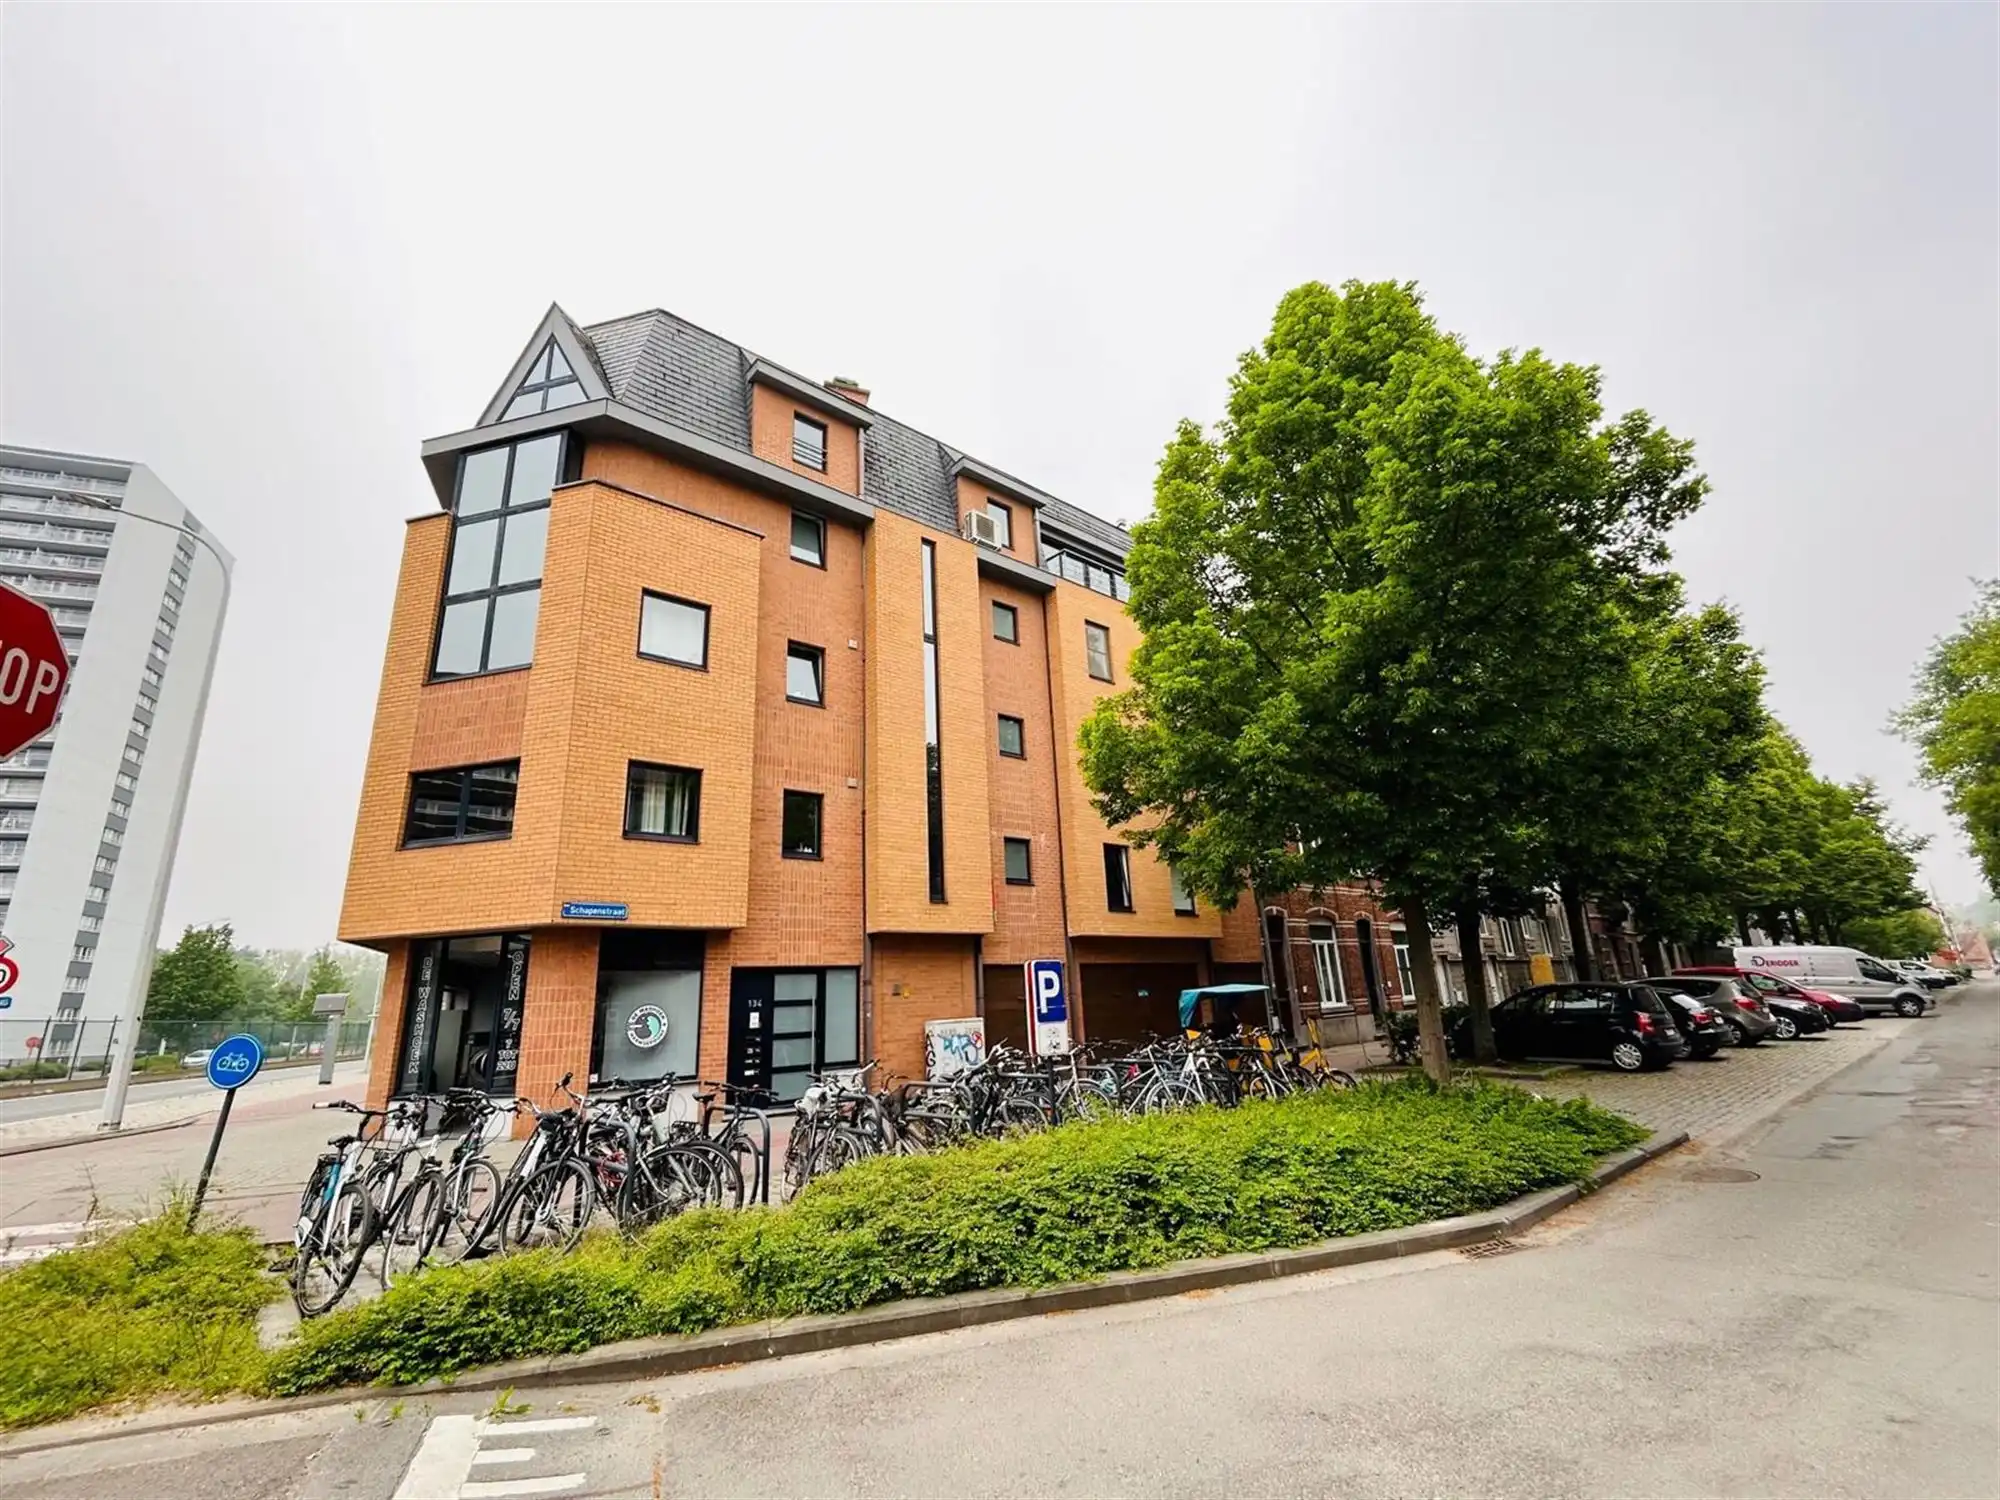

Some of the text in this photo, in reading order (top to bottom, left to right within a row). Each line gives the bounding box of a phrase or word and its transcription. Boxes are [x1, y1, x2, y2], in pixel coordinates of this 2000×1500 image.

[0, 640, 60, 715] OP
[570, 905, 625, 916] Schapenstraat
[508, 951, 524, 1000] OPEN
[1037, 970, 1060, 1013] P
